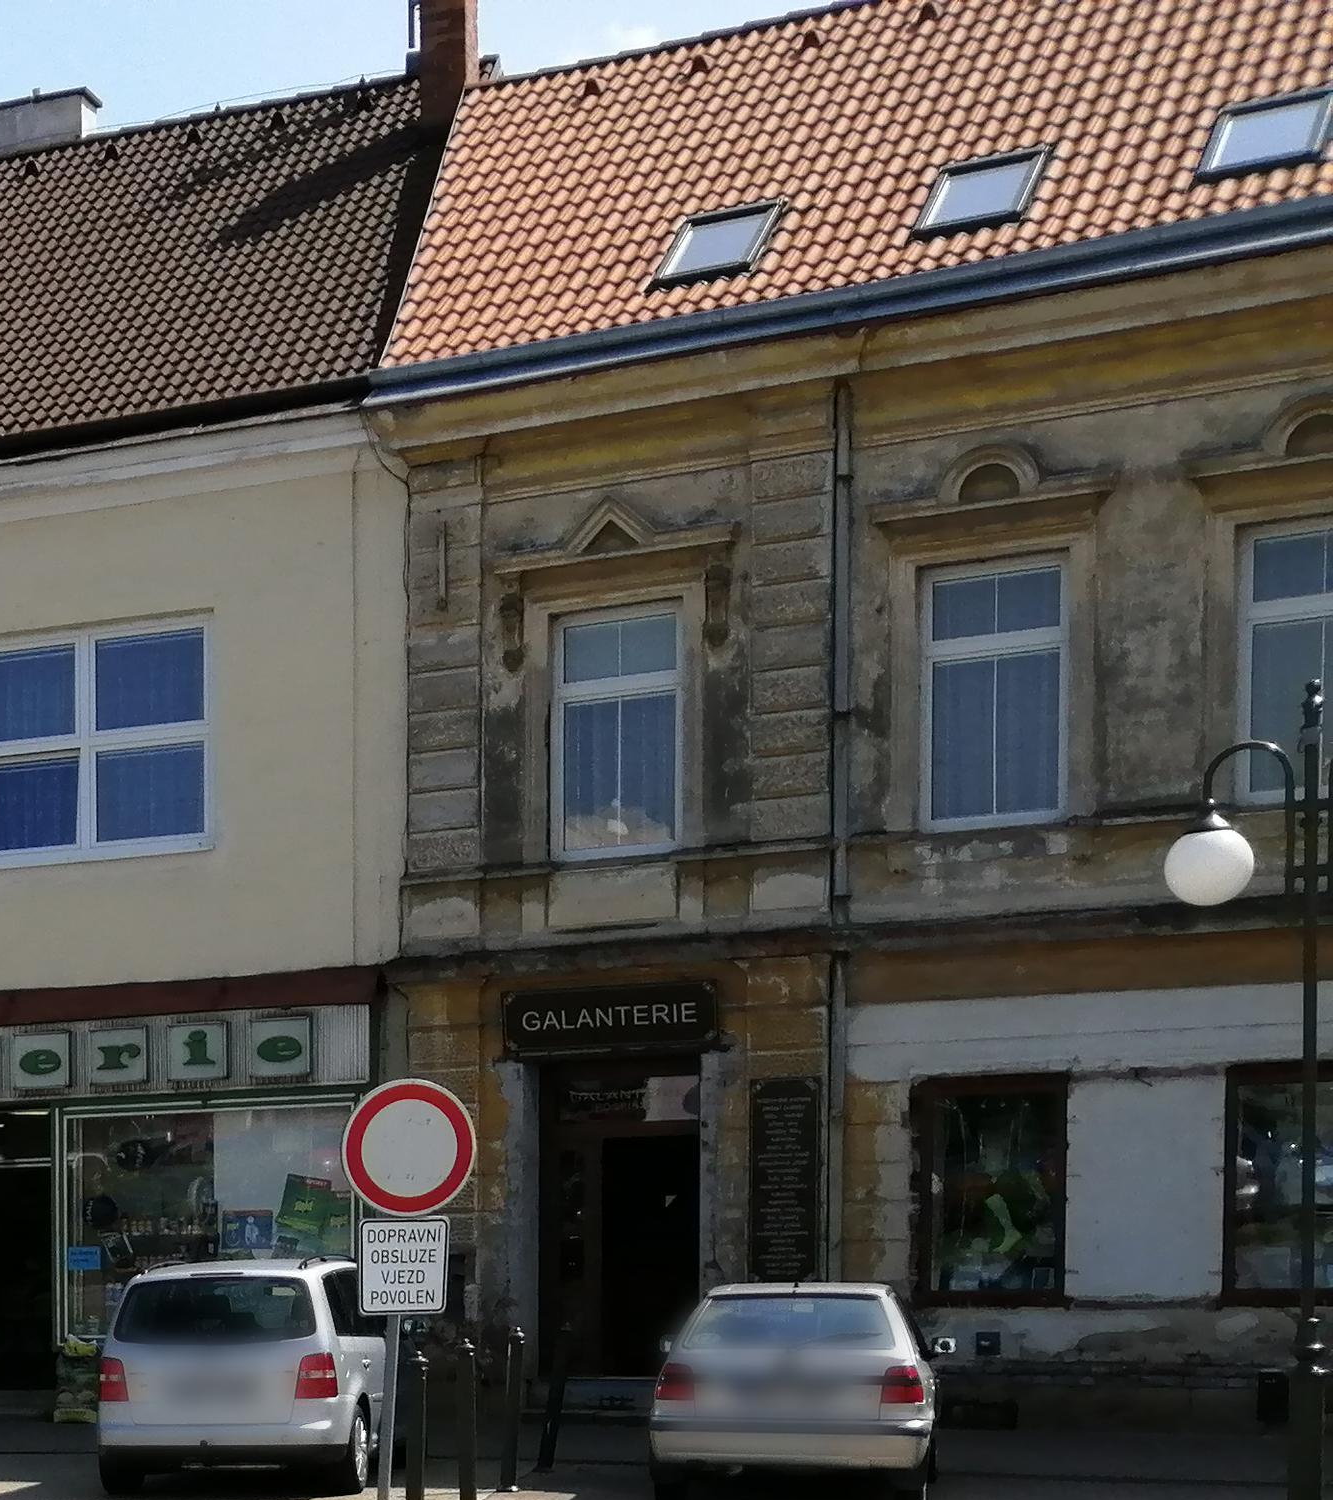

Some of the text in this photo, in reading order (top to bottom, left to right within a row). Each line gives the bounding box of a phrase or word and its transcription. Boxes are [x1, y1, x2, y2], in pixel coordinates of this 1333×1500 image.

[521, 1001, 698, 1032] GALANTERIE
[367, 1225, 443, 1243] DOPRAVNÍ
[371, 1249, 437, 1264] OBSLUZE
[381, 1269, 426, 1285] VJEZD
[370, 1289, 435, 1305] POVOLEN
